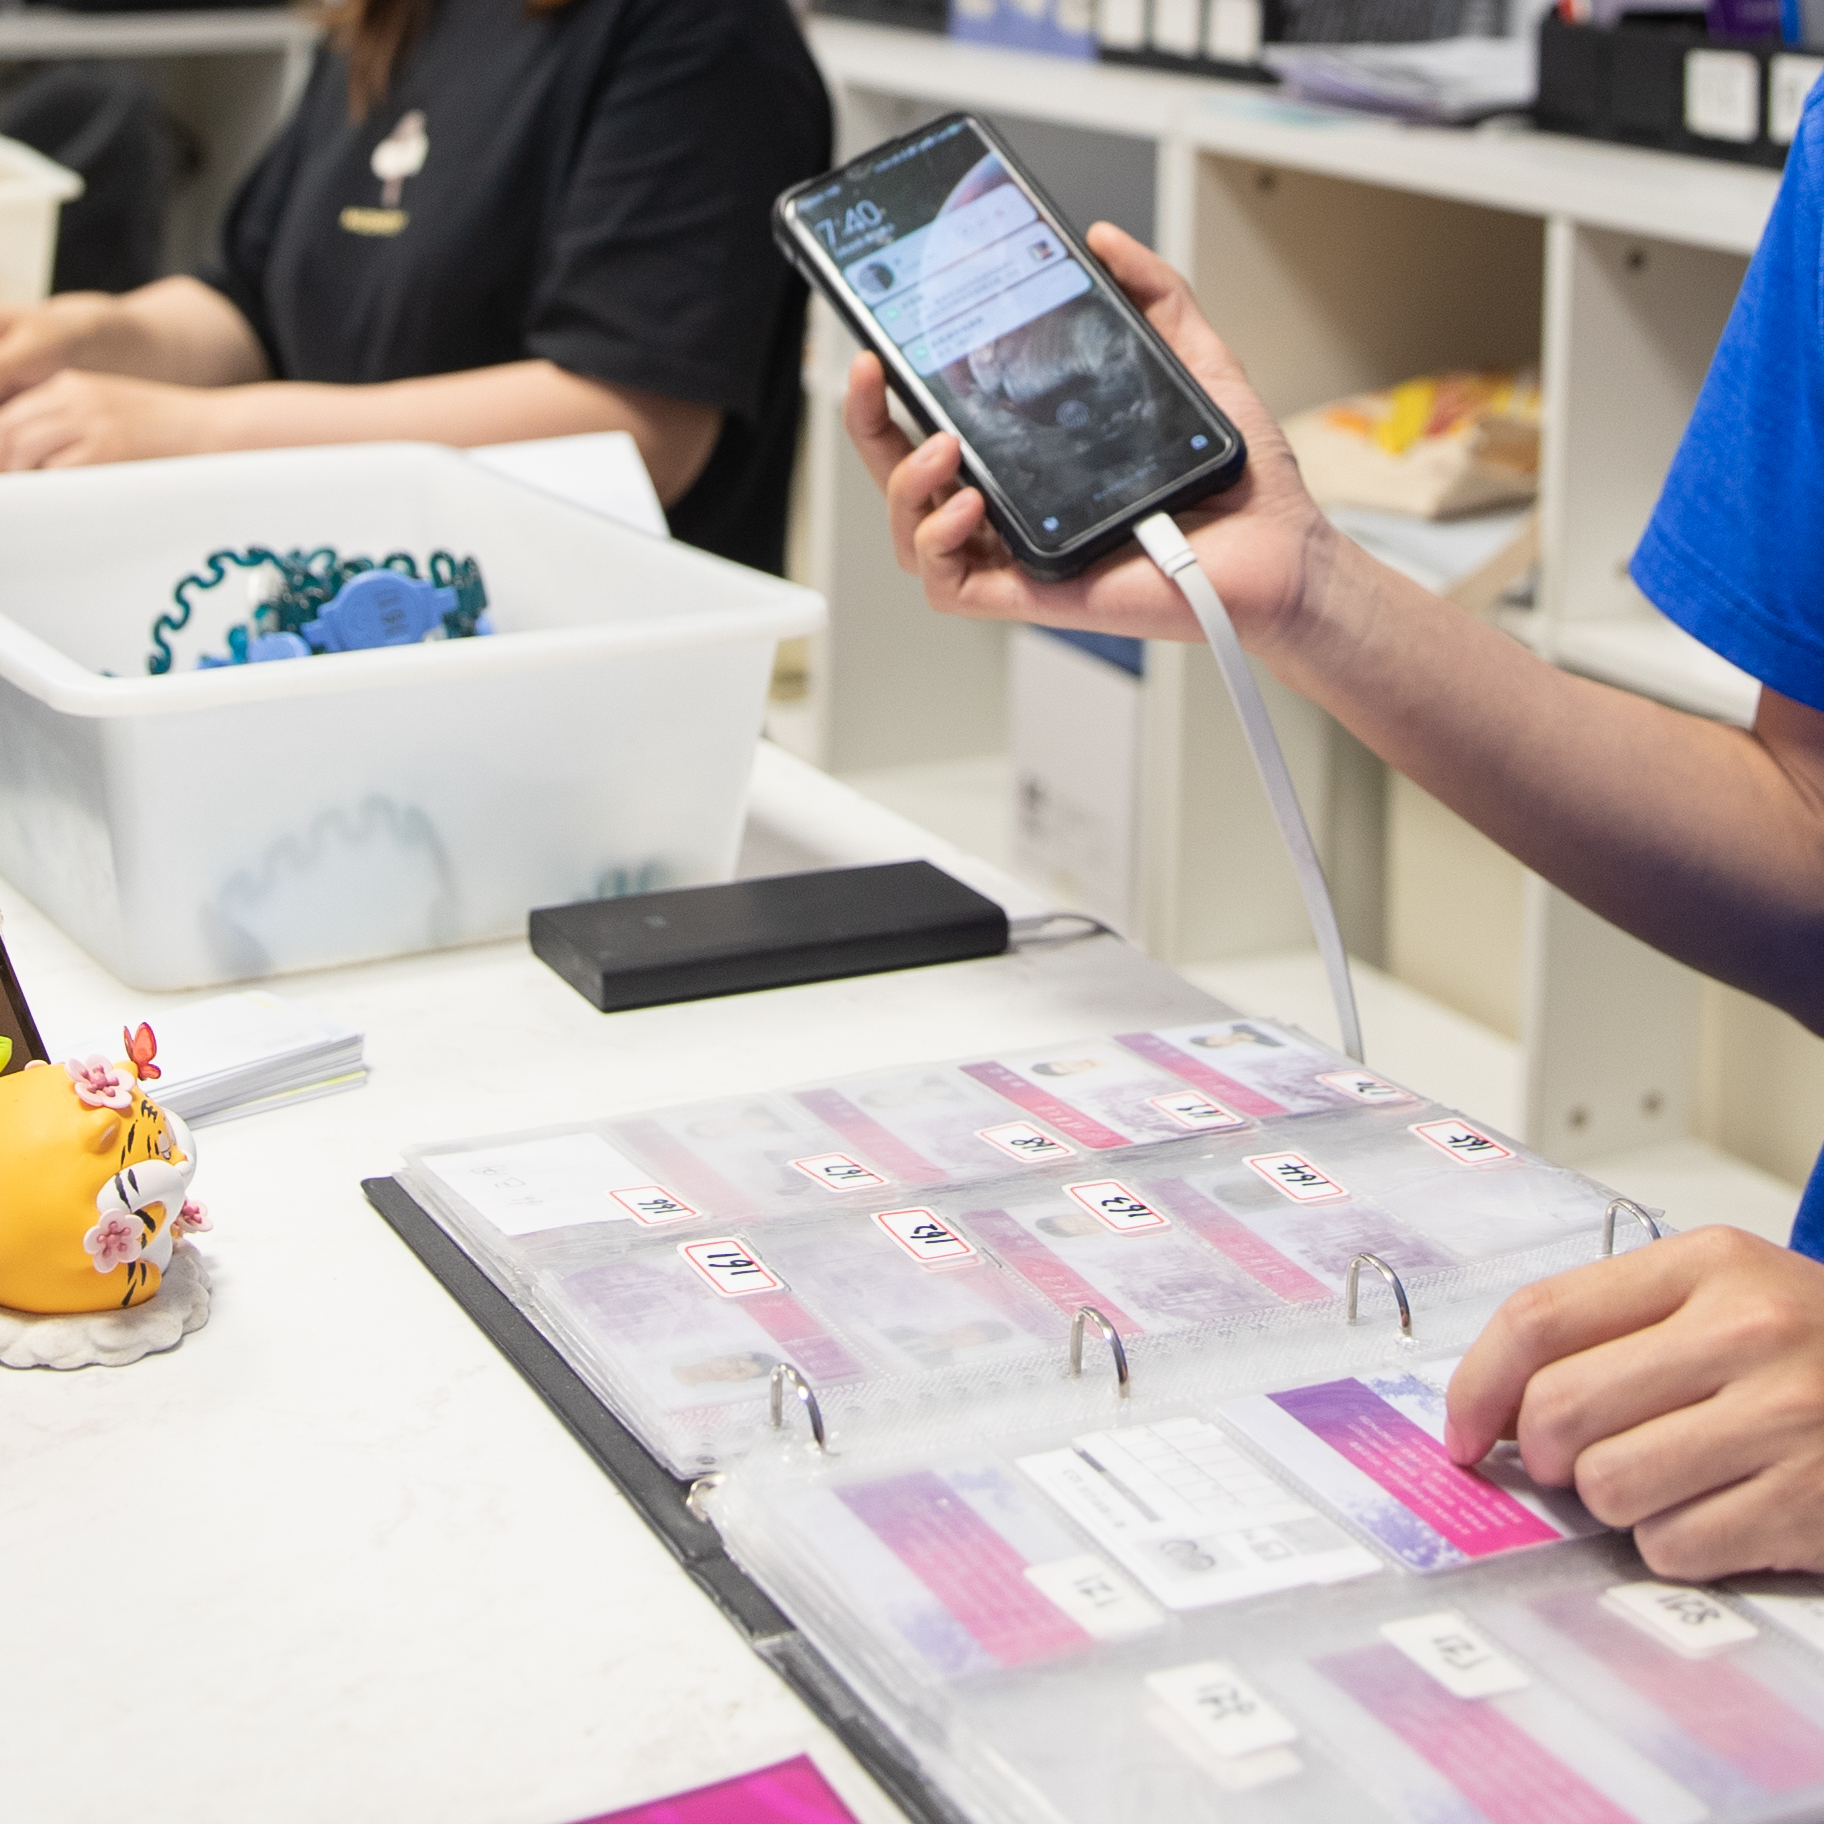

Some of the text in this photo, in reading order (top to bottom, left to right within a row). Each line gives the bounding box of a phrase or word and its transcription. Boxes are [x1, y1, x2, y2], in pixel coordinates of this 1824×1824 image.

[814, 199, 884, 250] 7:40
[1010, 1136, 1060, 1153] 168
[823, 1164, 876, 1180] 167
[1277, 1163, 1330, 1187] 164
[637, 1198, 687, 1214] 166
[1101, 1196, 1153, 1218] 163
[909, 1223, 959, 1244] 162
[706, 1252, 761, 1276] 161
